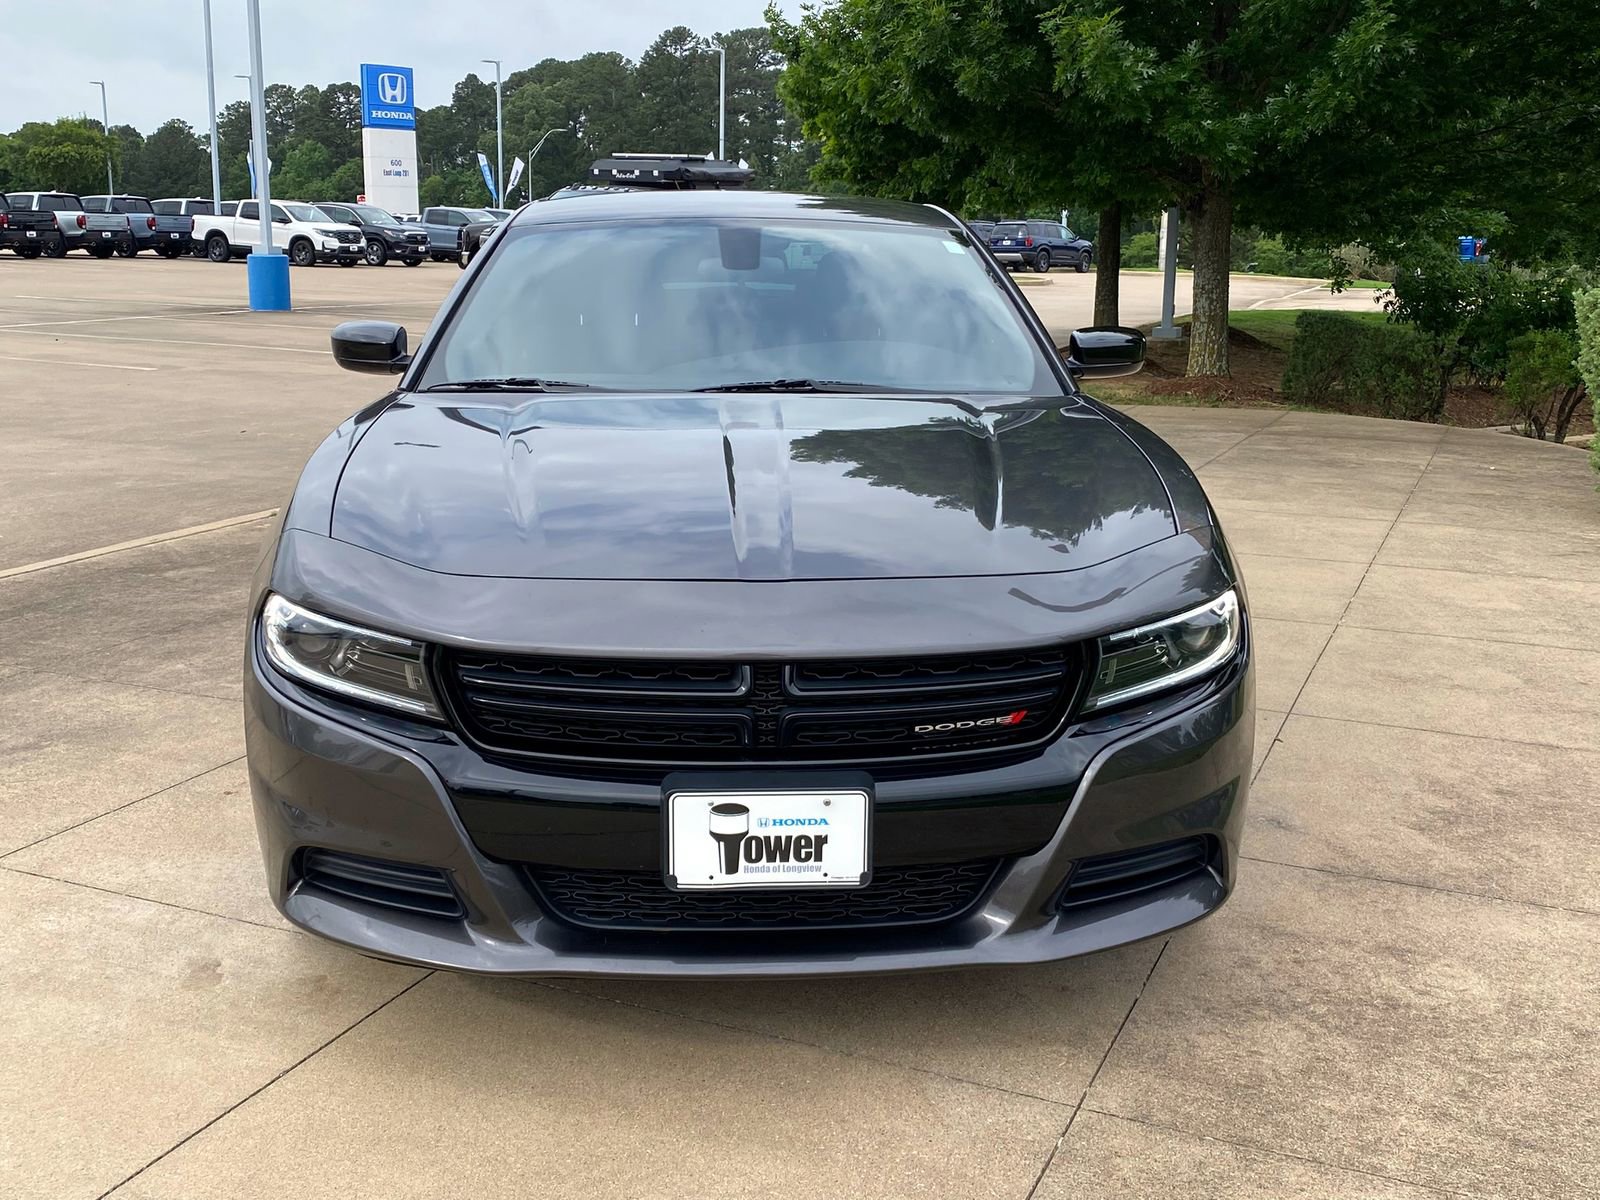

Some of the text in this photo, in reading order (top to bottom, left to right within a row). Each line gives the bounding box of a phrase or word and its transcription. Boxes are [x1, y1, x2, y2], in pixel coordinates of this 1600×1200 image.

[371, 110, 414, 120] HONDA
[390, 159, 402, 167] 600
[914, 715, 1014, 733] DODGE
[772, 818, 829, 827] HONDA
[743, 864, 822, 874] Honda of Longview
